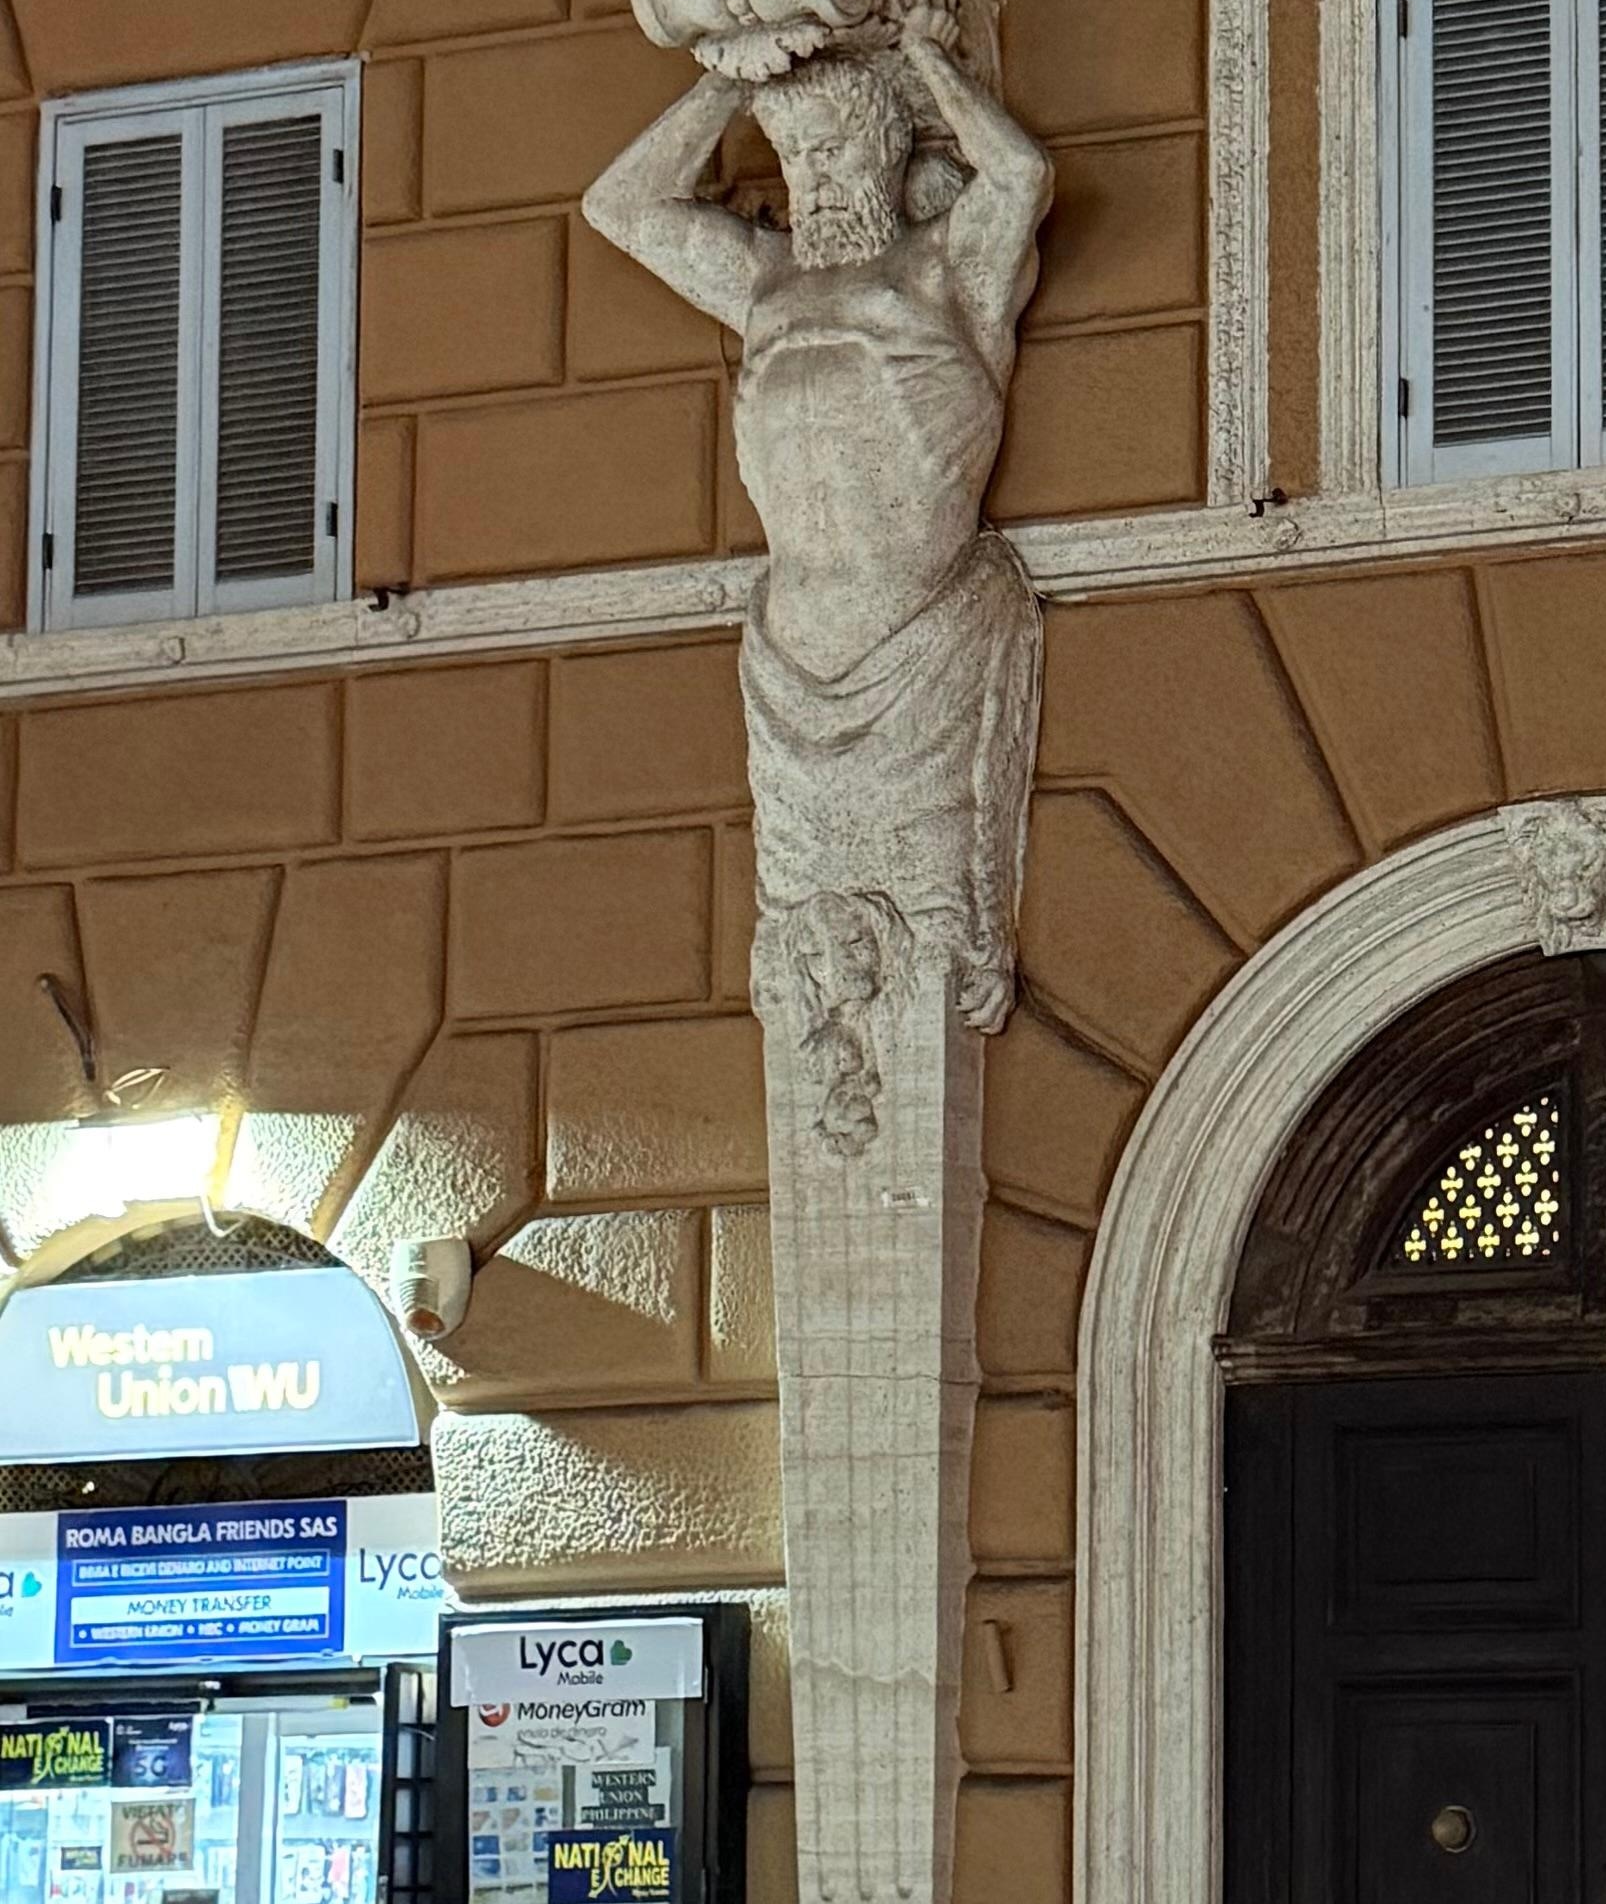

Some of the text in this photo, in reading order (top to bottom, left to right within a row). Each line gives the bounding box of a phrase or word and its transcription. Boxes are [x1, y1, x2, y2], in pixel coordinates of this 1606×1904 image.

[48, 1323, 213, 1368] Western
[98, 1364, 227, 1418] Union
[66, 1516, 337, 1548] ROMA BANGLA FRIENDS SAS
[287, 1555, 322, 1569] POINT
[127, 1595, 271, 1615] MONEY TRANSFER
[520, 1636, 604, 1676] Lyca
[557, 1671, 604, 1685] Mobile
[517, 1699, 646, 1724] MoneyGram
[1, 1731, 104, 1758] NATIONAL
[134, 1755, 166, 1777] 5G
[592, 1772, 656, 1786] WESTERN
[600, 1790, 643, 1804] UNION
[554, 1839, 670, 1869] NATIONAL
